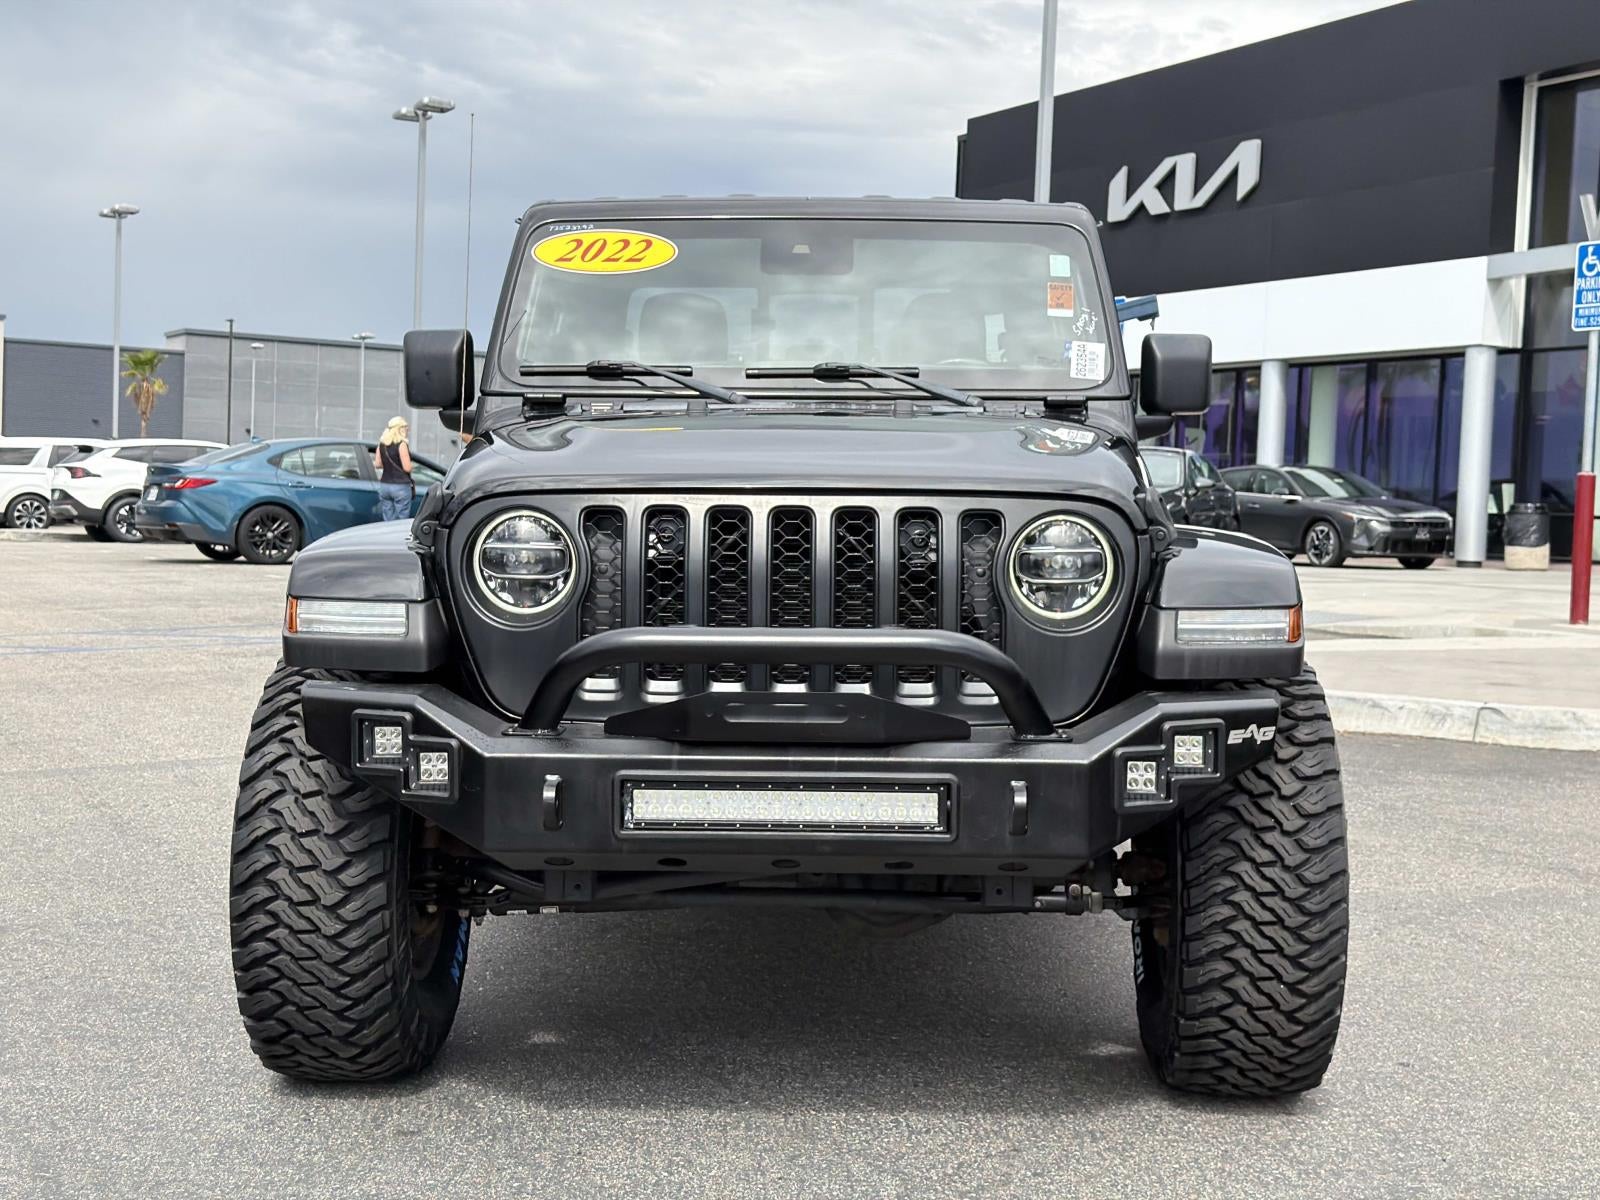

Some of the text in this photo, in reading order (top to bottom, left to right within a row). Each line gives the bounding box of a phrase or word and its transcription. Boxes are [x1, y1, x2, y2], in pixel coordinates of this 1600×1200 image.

[554, 238, 653, 263] 2022
[1576, 276, 1600, 290] PARKI
[1227, 723, 1276, 745] EAG
